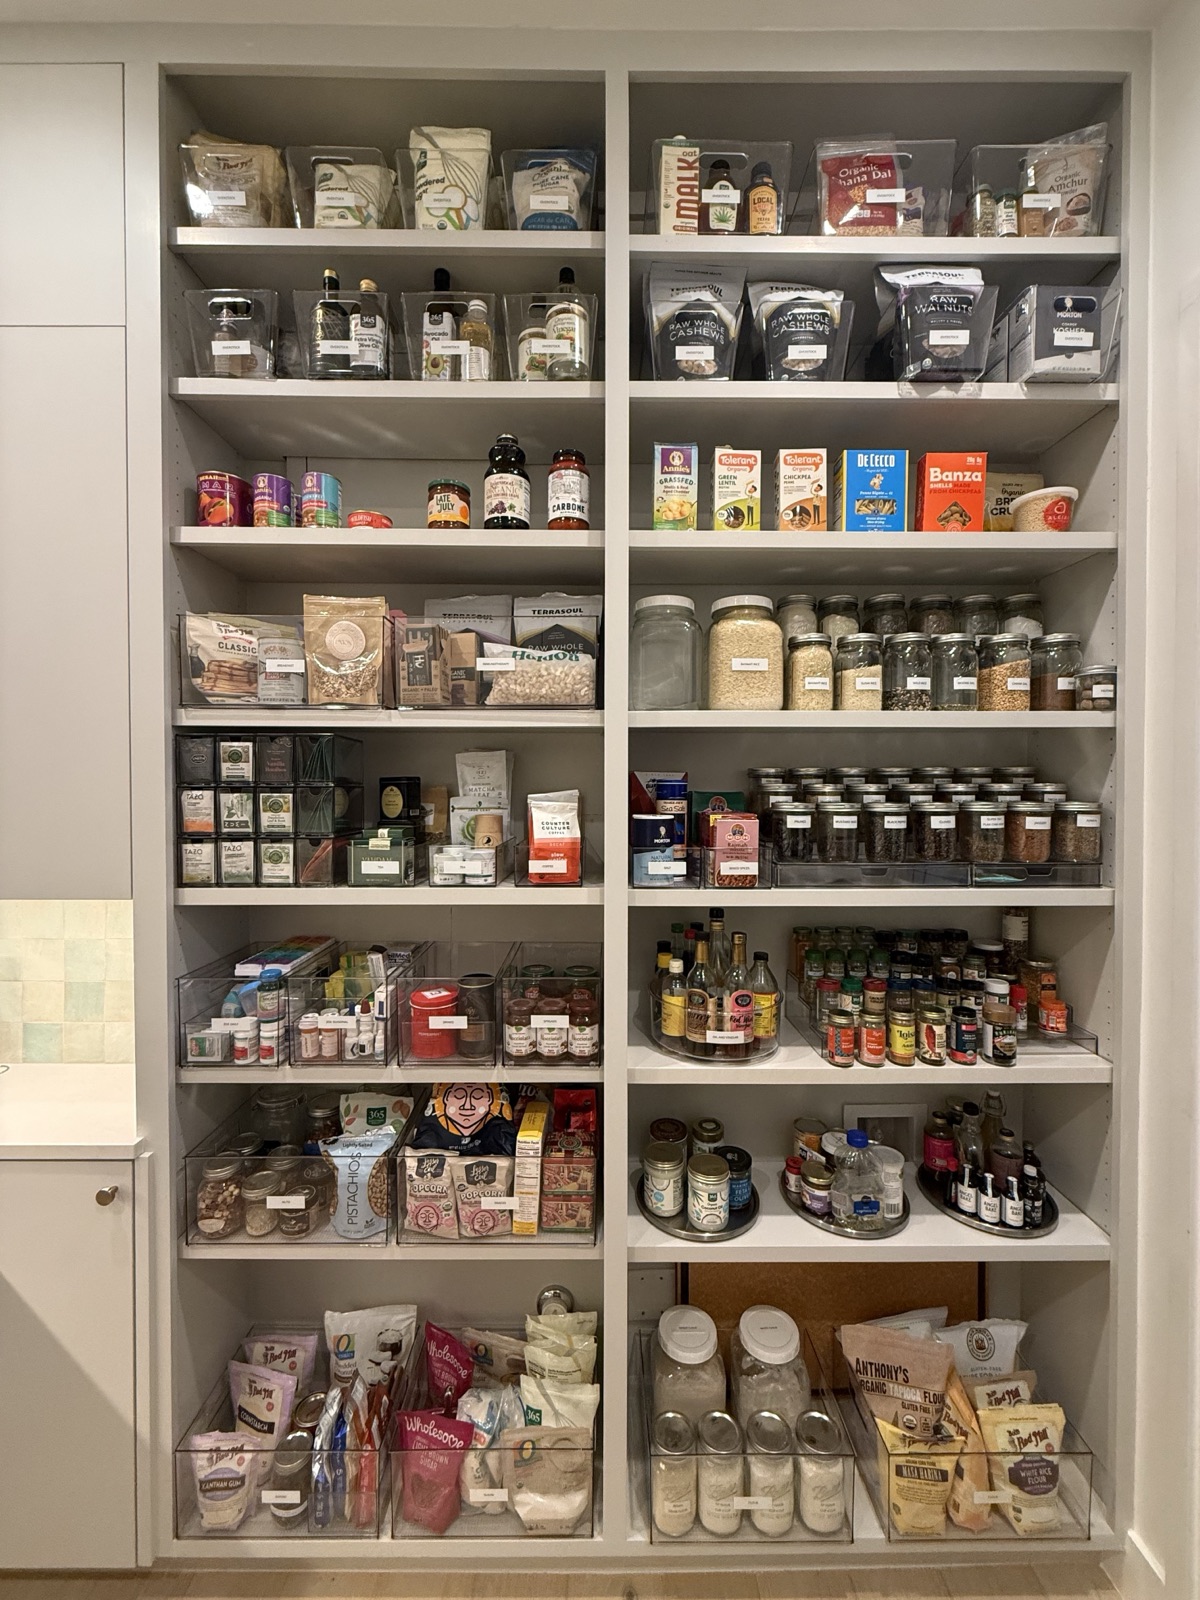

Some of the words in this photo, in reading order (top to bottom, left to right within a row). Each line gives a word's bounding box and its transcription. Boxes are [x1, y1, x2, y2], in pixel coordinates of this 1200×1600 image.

[839, 163, 879, 178] Organic
[872, 170, 892, 180] Dal
[1054, 170, 1081, 183] Organic
[416, 177, 445, 191] owdered
[1048, 178, 1088, 193] Amchur
[753, 197, 774, 205] LOCAL
[930, 296, 958, 304] RAW
[915, 304, 973, 316] WALNUTS
[362, 316, 375, 324] 365
[771, 315, 793, 328] RAW
[797, 314, 829, 325] WHOLE
[669, 320, 691, 331] RAW
[694, 320, 725, 334] WHOLE
[773, 321, 830, 338] CASHEWS
[669, 328, 724, 345] CASHEWS
[720, 455, 756, 465] Tolerant
[785, 455, 822, 465] Tolerant
[858, 454, 869, 467] DE
[870, 454, 895, 467] CECCO
[663, 465, 690, 473] Annie's
[929, 467, 982, 482] Banza
[659, 477, 693, 486] GRASSFED
[1001, 488, 1025, 496] Organic
[435, 495, 451, 504] LATE
[438, 502, 455, 513] JULY
[552, 502, 585, 513] CARBONE
[218, 641, 257, 654] CLASSIC
[551, 643, 584, 651] WHOLE
[368, 1110, 385, 1119] 365
[346, 1151, 362, 1225] PISTACHIOS
[461, 1190, 505, 1200] POPCORN
[269, 1351, 284, 1363] Red
[284, 1348, 297, 1361] Mill
[427, 1340, 468, 1379] Wholesome
[855, 1358, 910, 1384] ANTHONY'S
[253, 1387, 263, 1397] Red
[860, 1379, 887, 1395] RGANIC
[888, 1384, 922, 1402] TAPIOCA
[901, 1402, 918, 1412] GLUTEN
[920, 1406, 931, 1414] FREE
[240, 1411, 268, 1432] CORNSTARCH
[526, 1410, 540, 1422] 365
[405, 1416, 464, 1452] Wholesome
[1016, 1433, 1032, 1451] Red
[1031, 1427, 1049, 1448] Mill
[419, 1455, 438, 1471] SUGAR
[901, 1466, 919, 1478] MASA
[920, 1468, 943, 1481] HARINA
[1020, 1469, 1038, 1477] WHITE
[202, 1480, 228, 1490] XANTHAN
[229, 1479, 242, 1488] GUM
[1028, 1476, 1047, 1485] FLOUR
